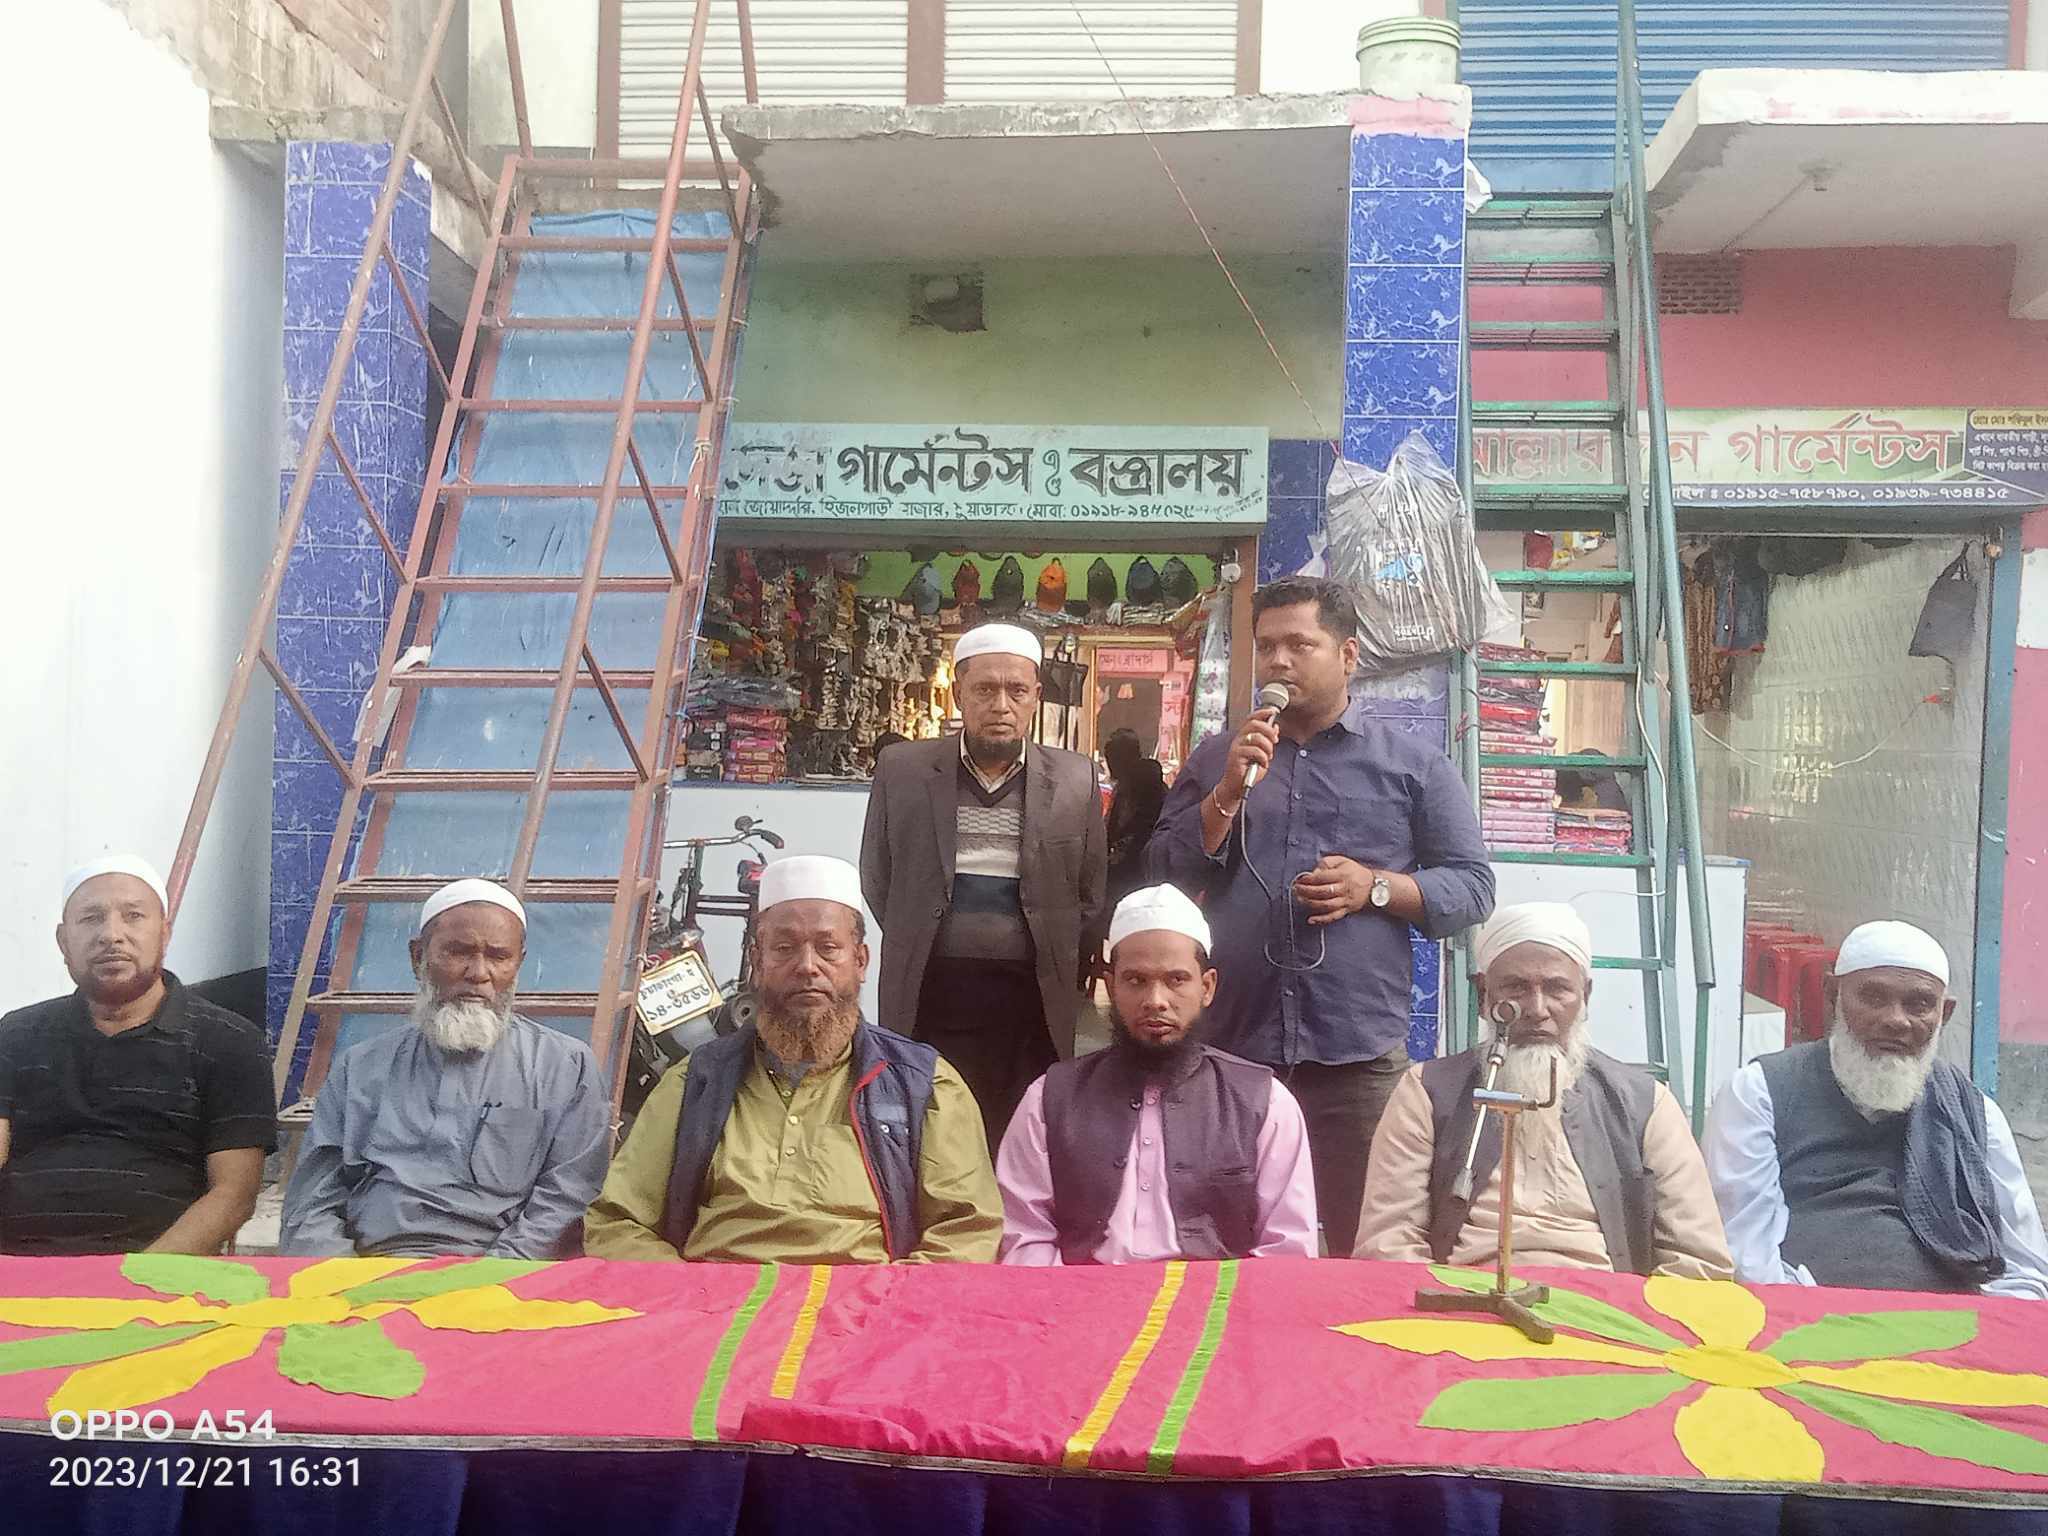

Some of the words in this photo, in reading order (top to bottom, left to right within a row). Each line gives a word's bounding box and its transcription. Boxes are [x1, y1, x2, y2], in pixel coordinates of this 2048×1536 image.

[836, 426, 1034, 496] গার্মেন্টস
[1067, 447, 1253, 497] বস্ত্রালয়
[1728, 411, 1959, 474] গার্মেন্টস
